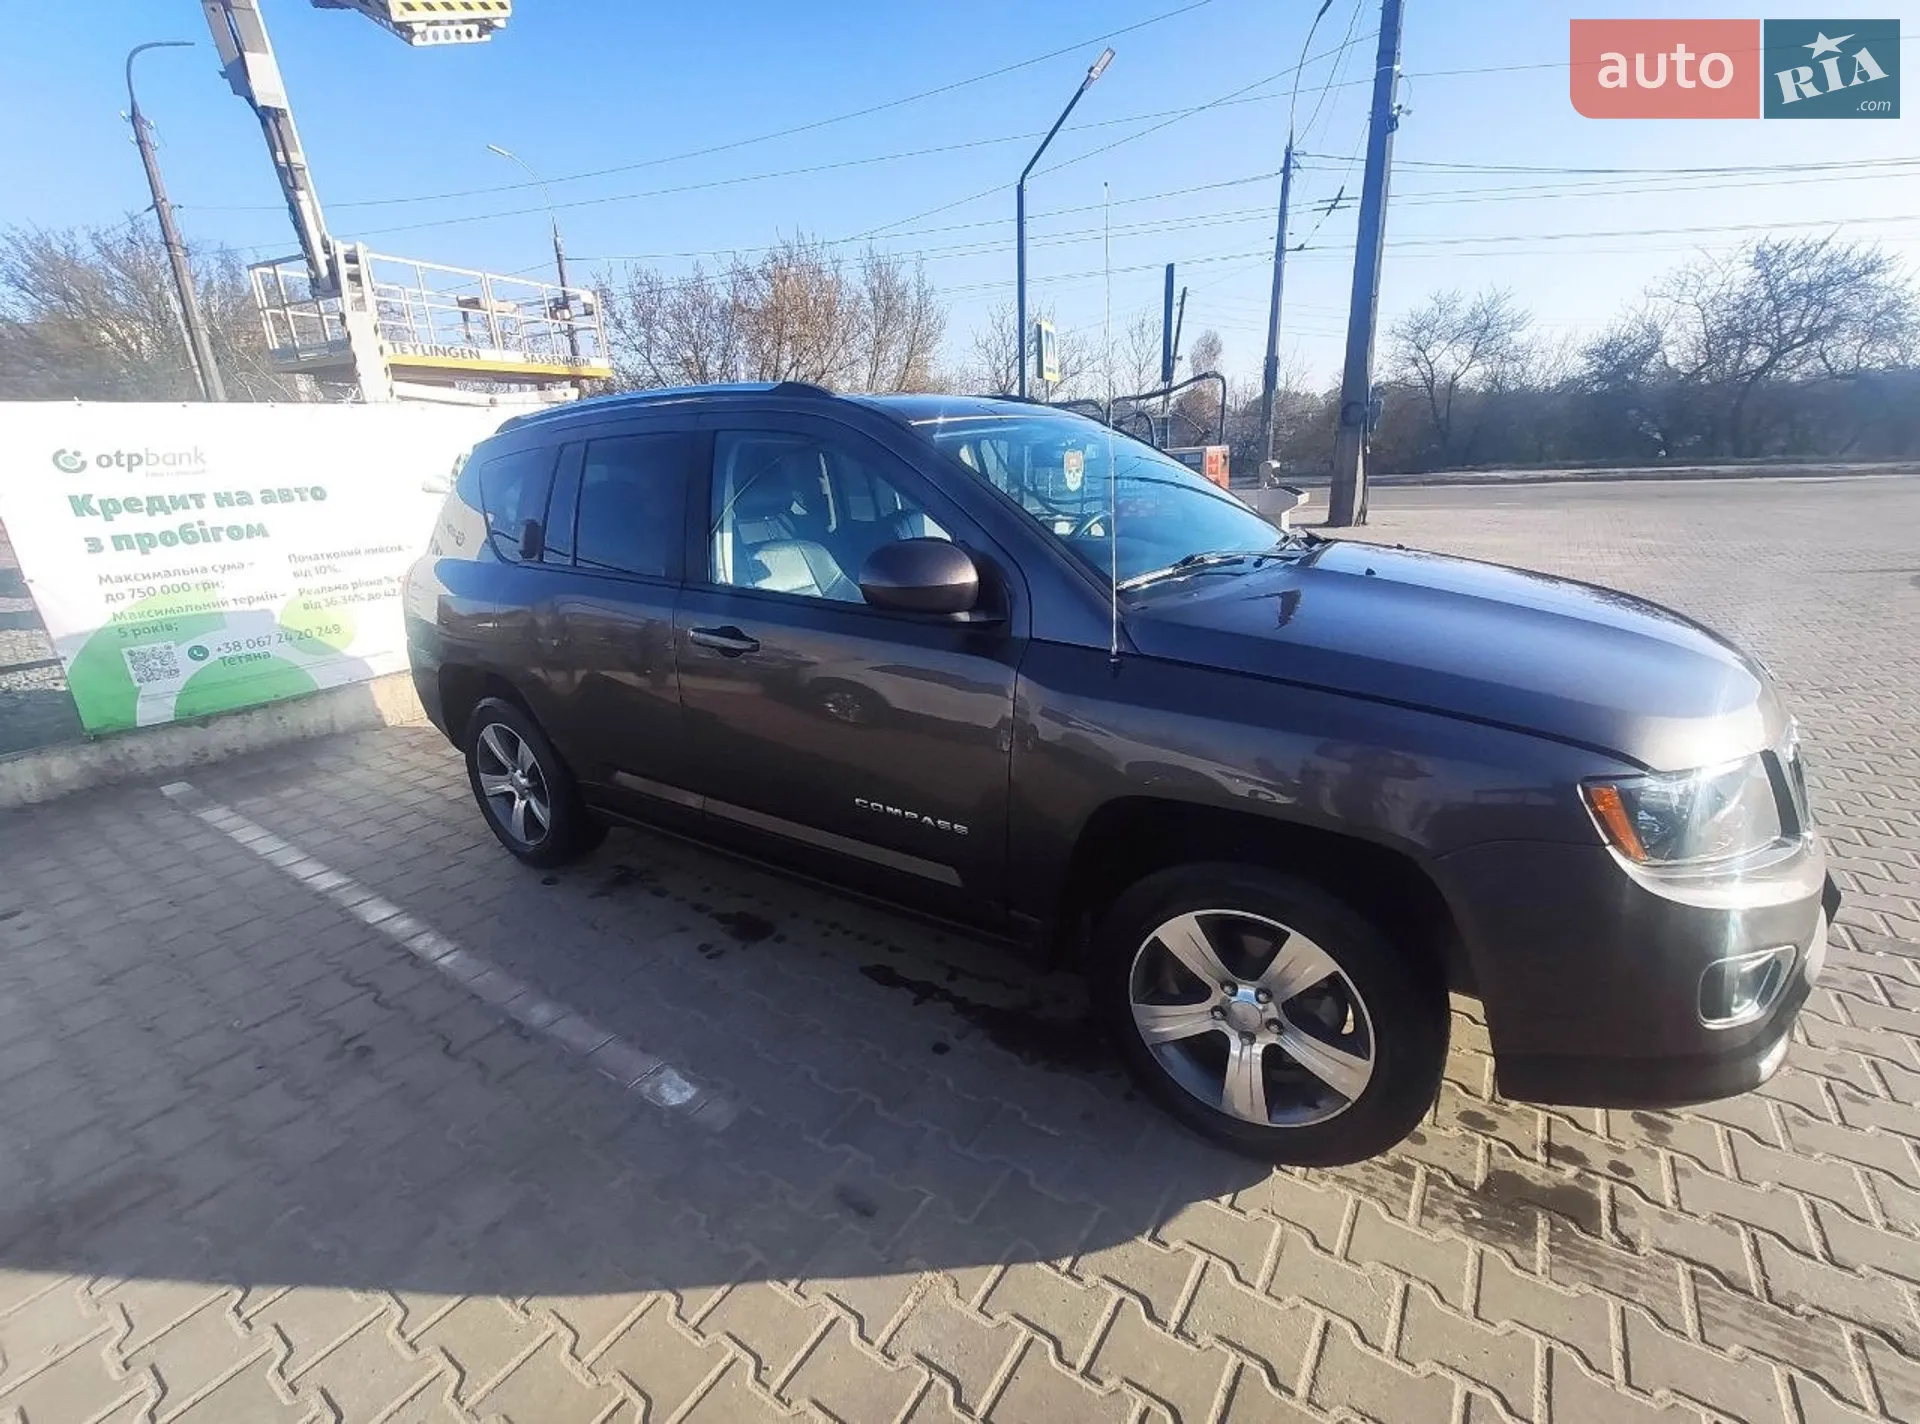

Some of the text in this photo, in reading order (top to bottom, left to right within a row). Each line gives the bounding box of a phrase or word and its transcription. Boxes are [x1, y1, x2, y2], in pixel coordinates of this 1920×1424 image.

[389, 342, 481, 360] TEYLINGEN
[523, 352, 592, 368] SASSENHEIM
[68, 485, 328, 522] Кредит на авто
[84, 520, 270, 555] з пробігом
[98, 564, 208, 586] Максимальна
[211, 561, 245, 576] сума
[105, 592, 126, 605] до
[129, 584, 158, 599] 750
[160, 581, 192, 596] 000
[112, 598, 229, 623] Максимальний
[232, 591, 278, 607] термін
[118, 621, 179, 641] 5 років;
[215, 623, 343, 655] +38 067 24 20 249
[218, 650, 273, 668] Тетяна
[855, 798, 968, 835] COMPASS
